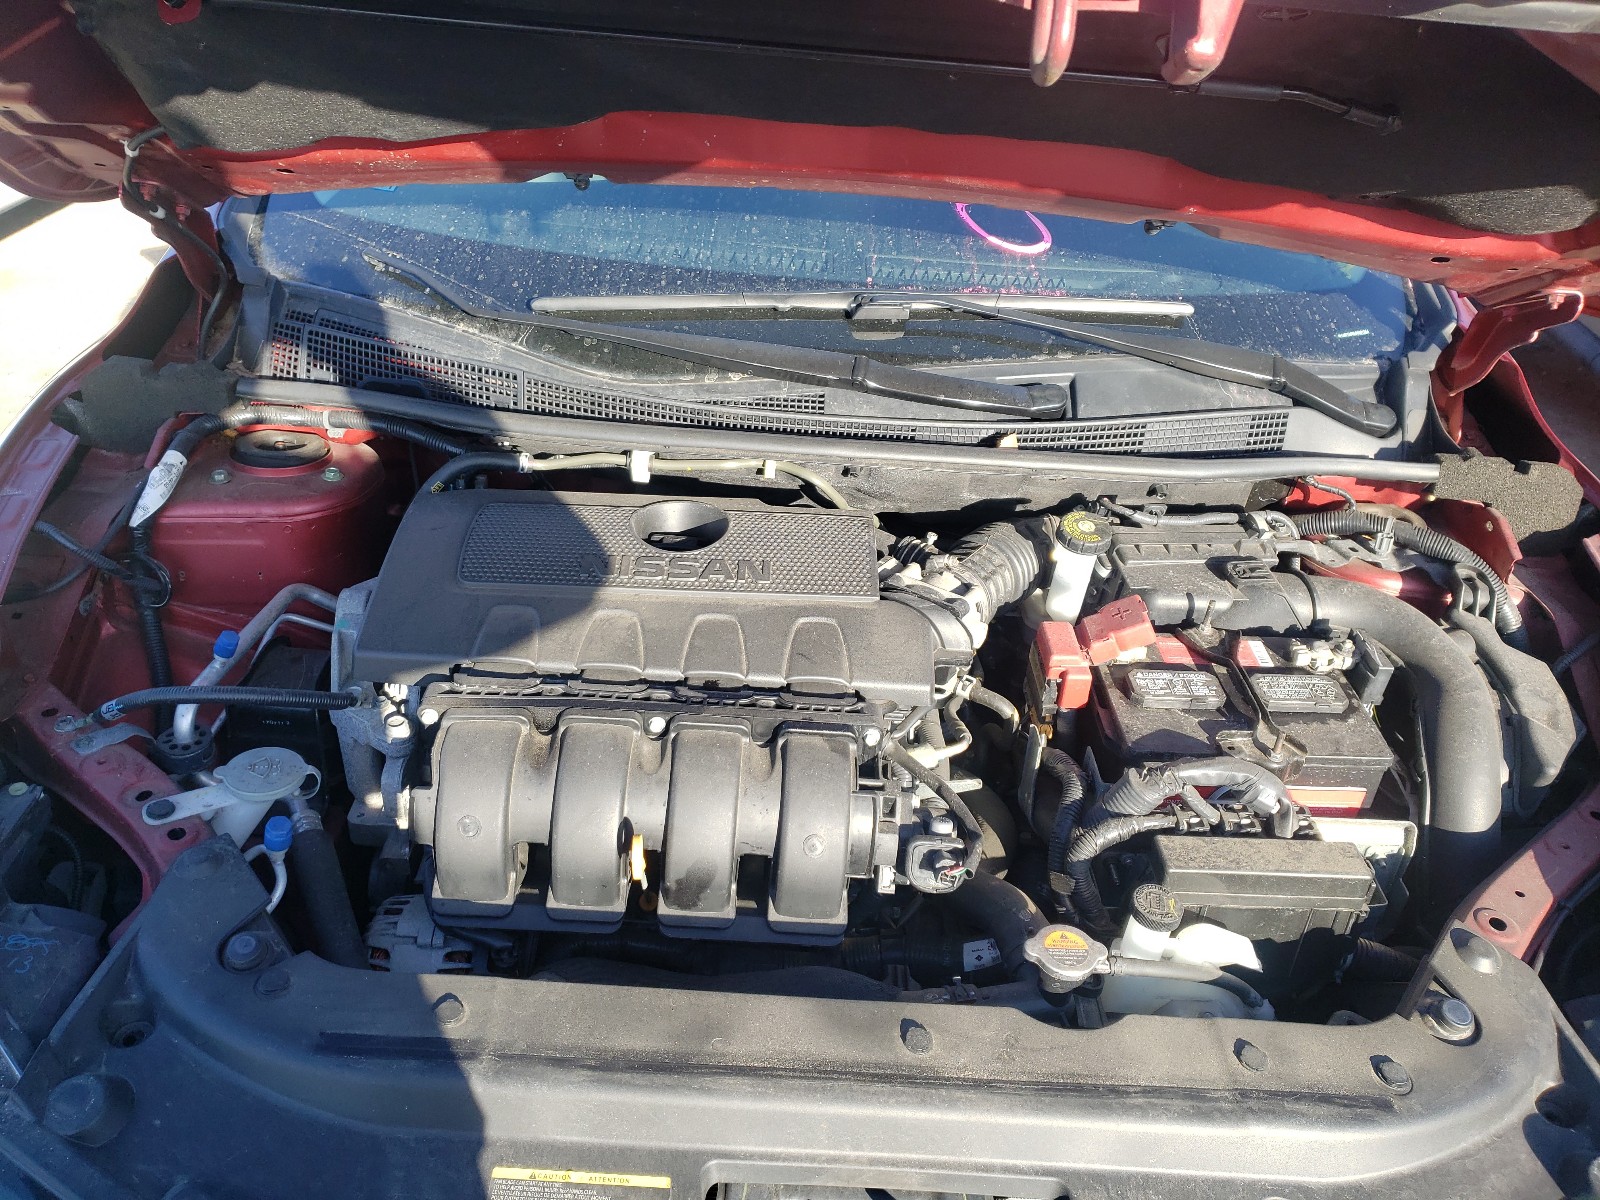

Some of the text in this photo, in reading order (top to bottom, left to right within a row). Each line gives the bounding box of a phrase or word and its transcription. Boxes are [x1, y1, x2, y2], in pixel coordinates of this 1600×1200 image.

[578, 554, 772, 584] NISSAN
[537, 1172, 630, 1184] CAUTION ATTENTION
